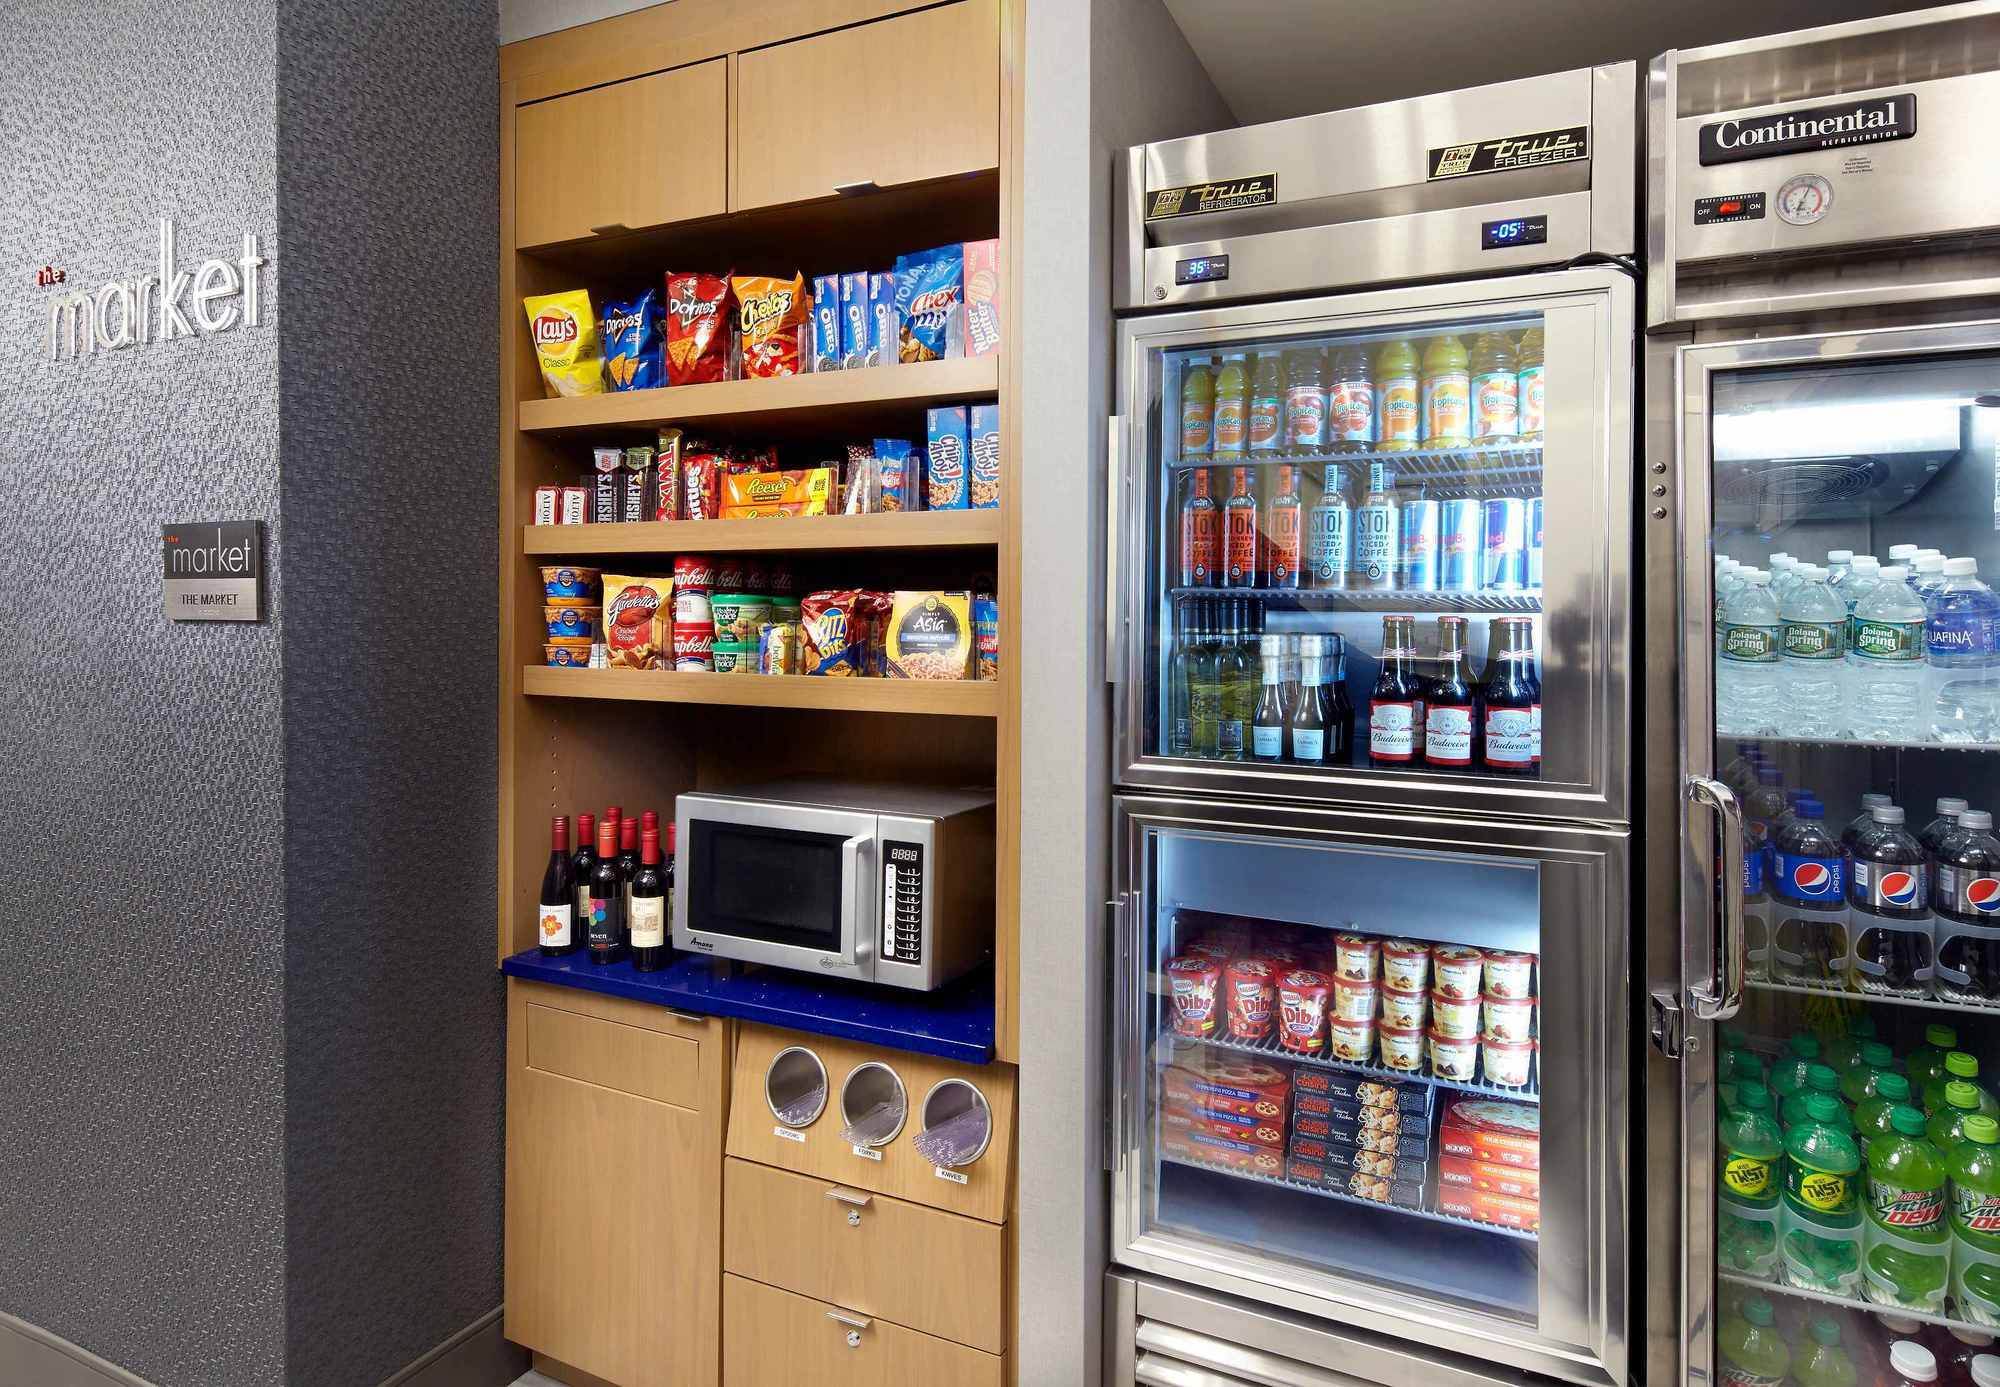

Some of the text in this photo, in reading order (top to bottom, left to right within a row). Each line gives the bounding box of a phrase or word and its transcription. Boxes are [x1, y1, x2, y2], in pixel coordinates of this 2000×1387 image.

[1716, 102, 1899, 149] Continental
[1483, 134, 1577, 159] true
[1821, 130, 1899, 147] REFRIGERATOR
[1494, 148, 1577, 168] FREEZER
[1190, 181, 1267, 201] true
[1199, 193, 1267, 210] REFRIGERATOR
[1697, 208, 1710, 216] OFF
[47, 217, 265, 361] market
[911, 285, 960, 315] Chex
[670, 298, 718, 315] Doritos
[741, 290, 793, 335] Cheetos
[536, 317, 576, 344] Lay's
[606, 312, 643, 335] Doritos
[820, 307, 835, 354] OREO
[850, 304, 864, 352] OREO
[875, 303, 888, 348] OREO
[542, 356, 571, 368] Classic
[940, 434, 959, 470] Chips
[658, 443, 674, 508] TWIX
[746, 478, 788, 496] Reese's
[598, 473, 613, 523] RSHEY'S
[626, 474, 641, 523] ERSHEY'S
[687, 465, 703, 521] kittles
[543, 493, 551, 525] ALTOI
[571, 493, 580, 525] ALTOI
[173, 527, 252, 573] market
[181, 593, 239, 606] THE MARKET
[607, 592, 660, 626] Gardetto's
[912, 615, 945, 632] Asia
[1788, 626, 1820, 637] Poland
[1862, 625, 1894, 637] Poland
[1727, 638, 1765, 653] Spring
[1730, 630, 1762, 641] Poland
[1785, 635, 1823, 650] Spring
[1858, 634, 1897, 650] Spring
[1427, 735, 1469, 748] Budweiser
[1831, 864, 1840, 893] pepsi
[1178, 993, 1213, 1010] Dibs
[940, 1170, 962, 1181] KNIVES
